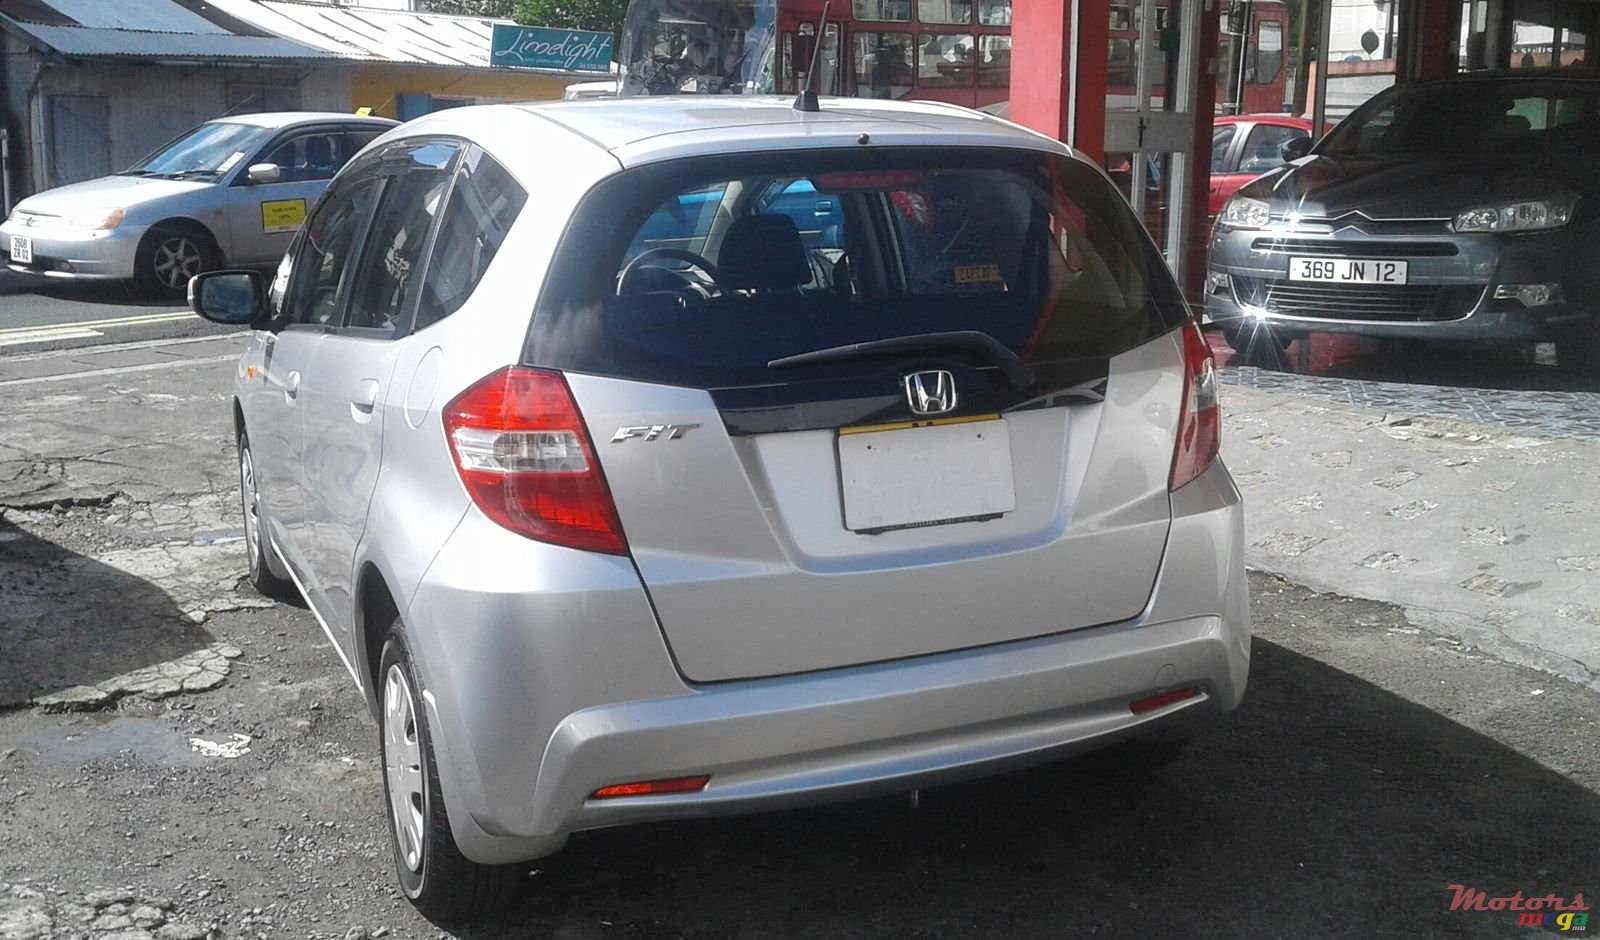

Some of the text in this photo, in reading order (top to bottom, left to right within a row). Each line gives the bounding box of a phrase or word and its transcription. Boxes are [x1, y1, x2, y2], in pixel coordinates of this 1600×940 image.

[495, 29, 610, 68] Limelight
[1301, 260, 1396, 282] 369 JN 12
